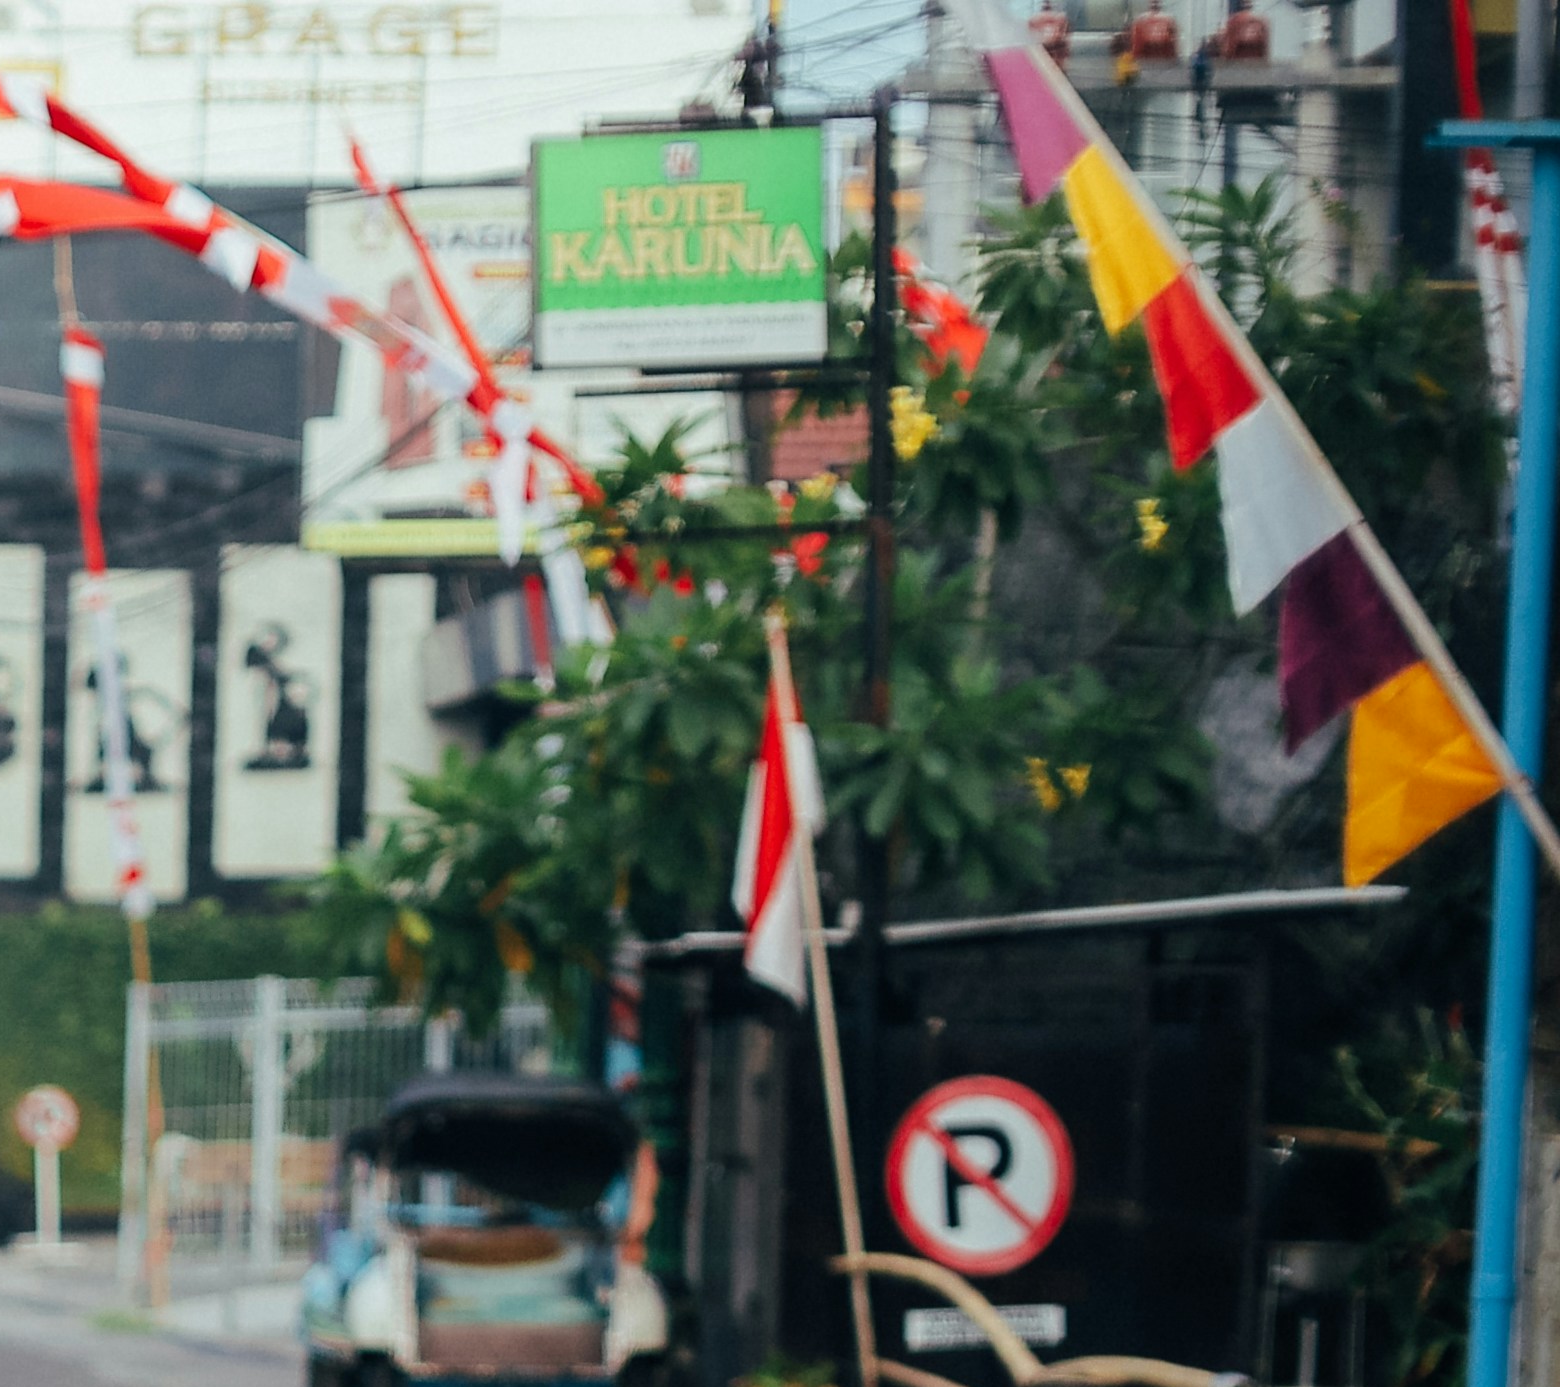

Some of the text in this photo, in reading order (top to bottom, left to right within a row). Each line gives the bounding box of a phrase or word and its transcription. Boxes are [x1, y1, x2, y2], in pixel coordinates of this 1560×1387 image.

[132, 4, 499, 57] GRAGE
[603, 182, 763, 227] HOTEL
[550, 223, 818, 282] KARUNIA
[942, 1123, 1013, 1229] P
